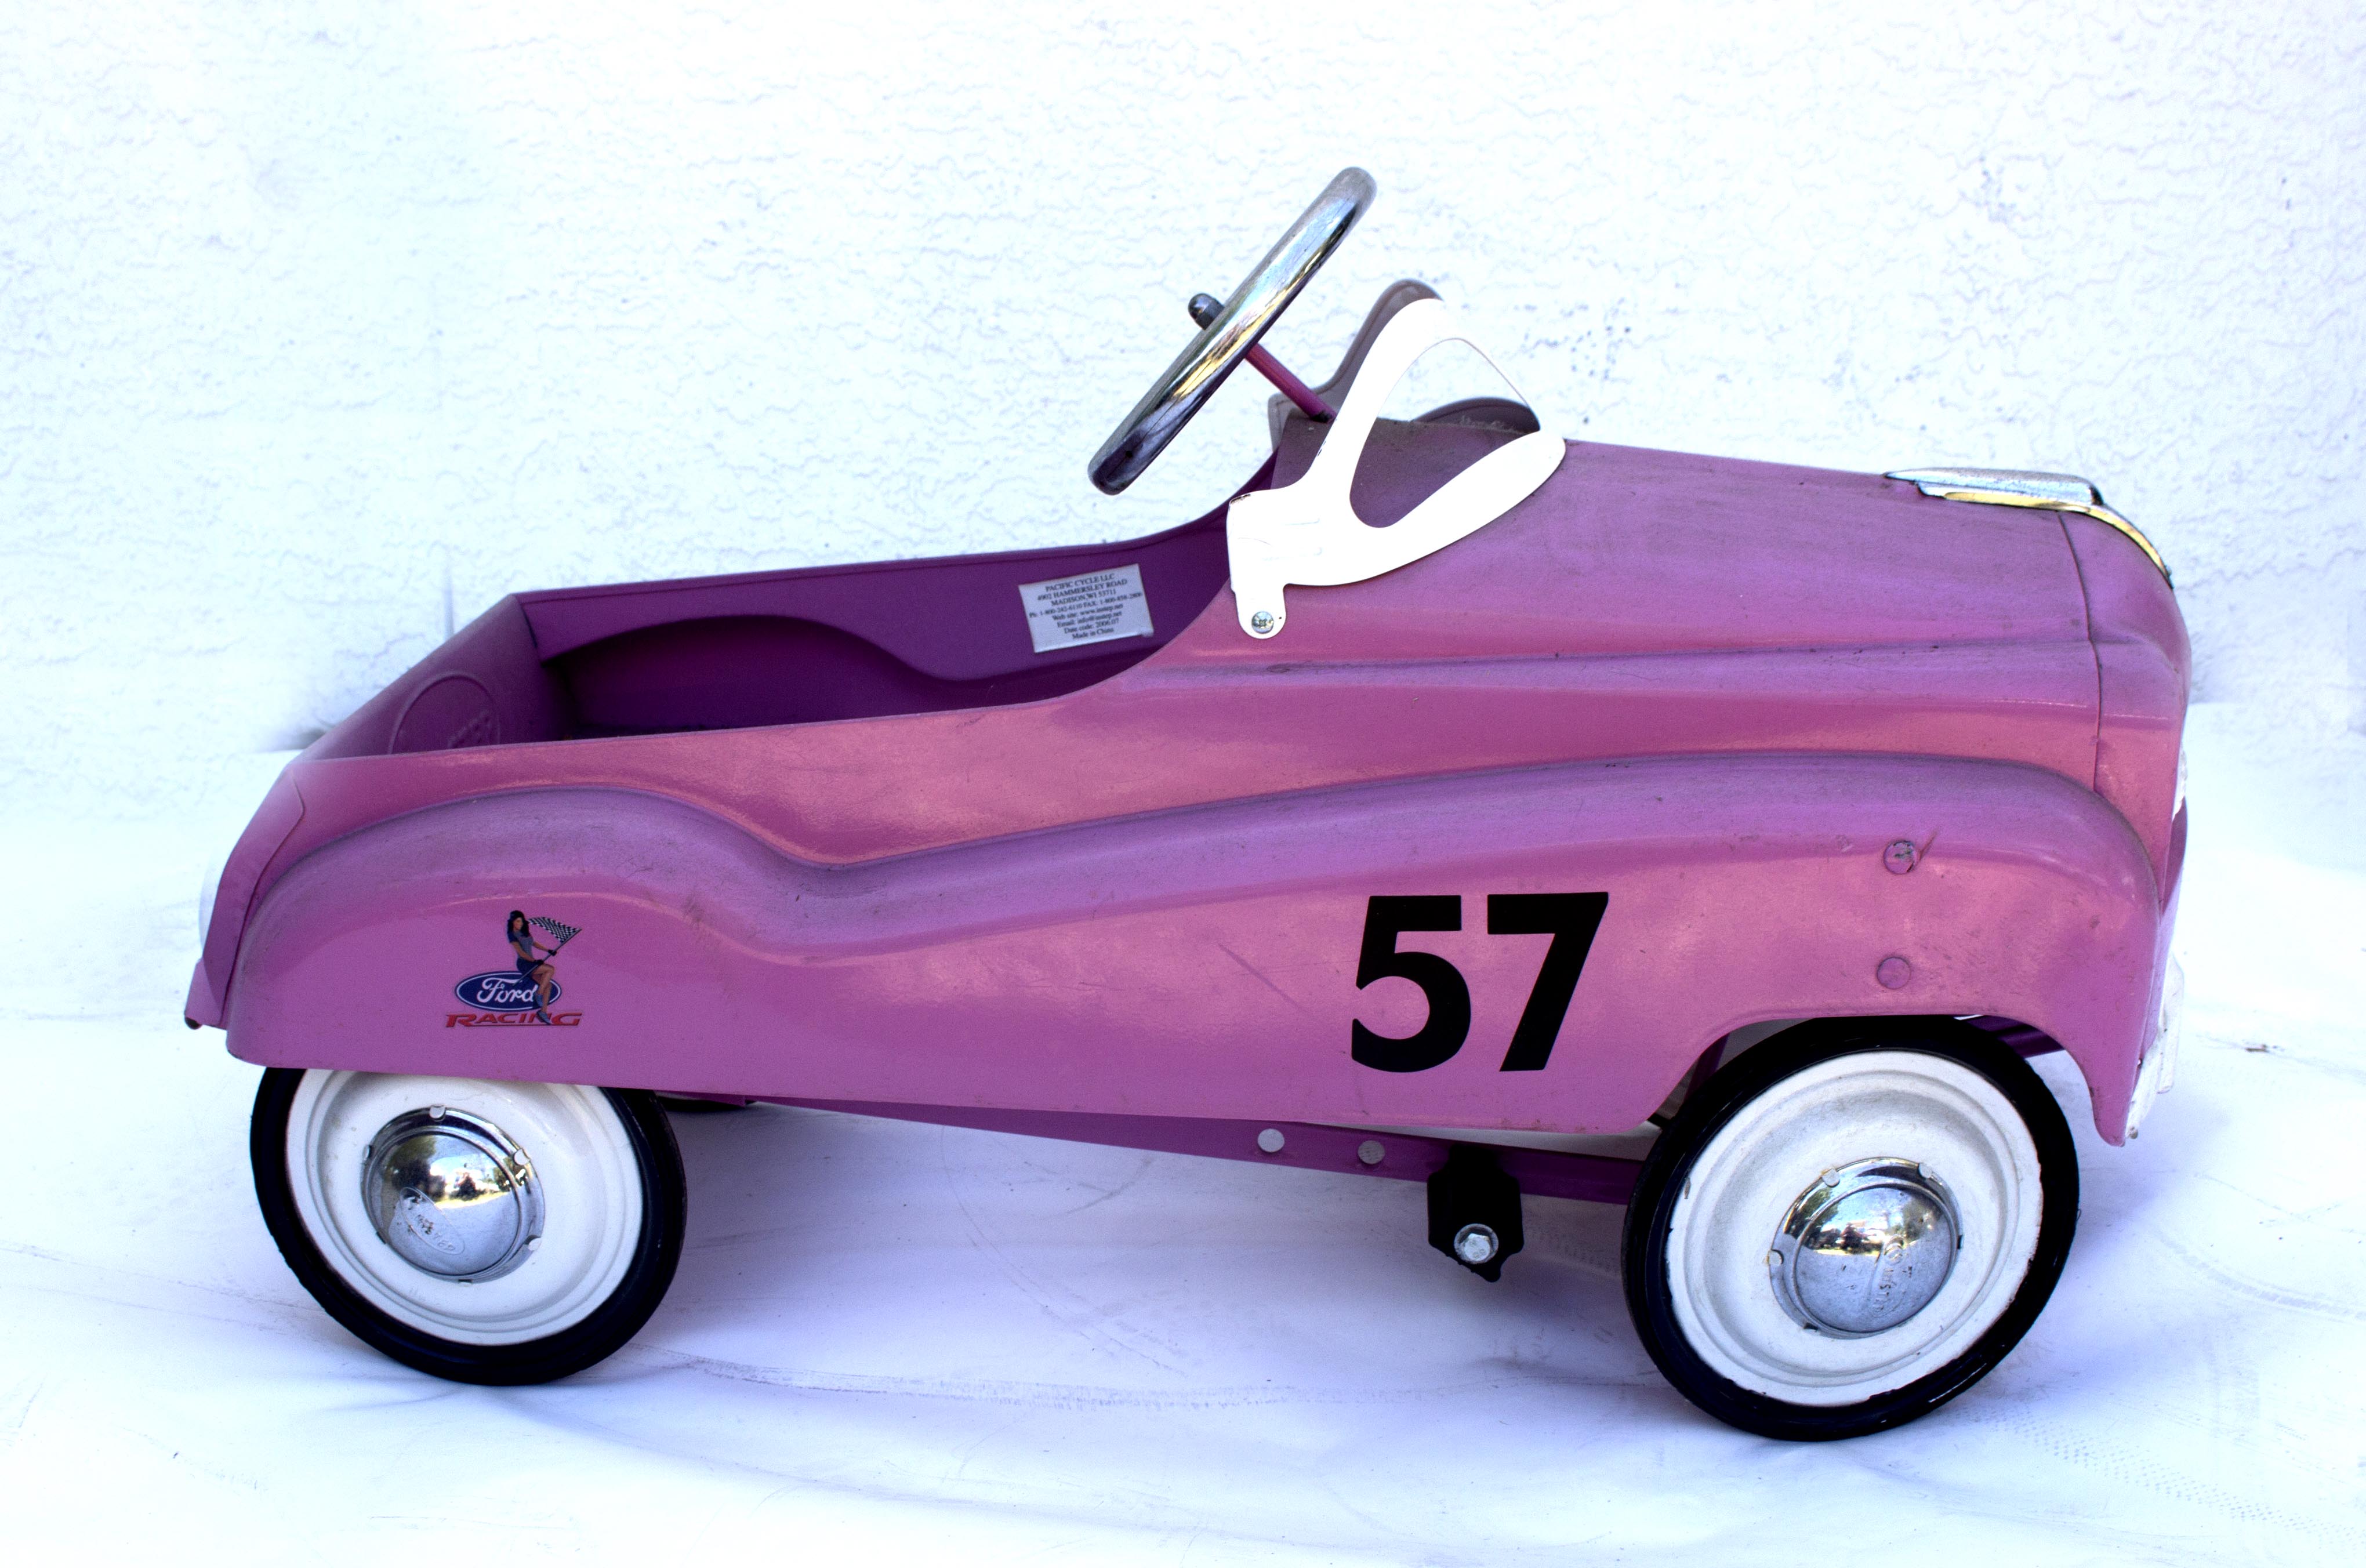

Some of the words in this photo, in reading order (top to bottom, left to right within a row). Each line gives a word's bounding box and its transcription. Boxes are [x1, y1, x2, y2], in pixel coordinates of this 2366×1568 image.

[1045, 581, 1072, 591] PACIFIC
[1073, 576, 1101, 586] CYCLE
[1053, 583, 1105, 597] HAMMERSLEY
[1106, 579, 1127, 587] ROAD
[1098, 589, 1116, 597] 53711
[1072, 631, 1088, 639] Made
[1096, 626, 1113, 634] China
[476, 977, 539, 1003] Ford
[1352, 892, 1609, 1073] 57
[445, 1012, 582, 1028] RACING
